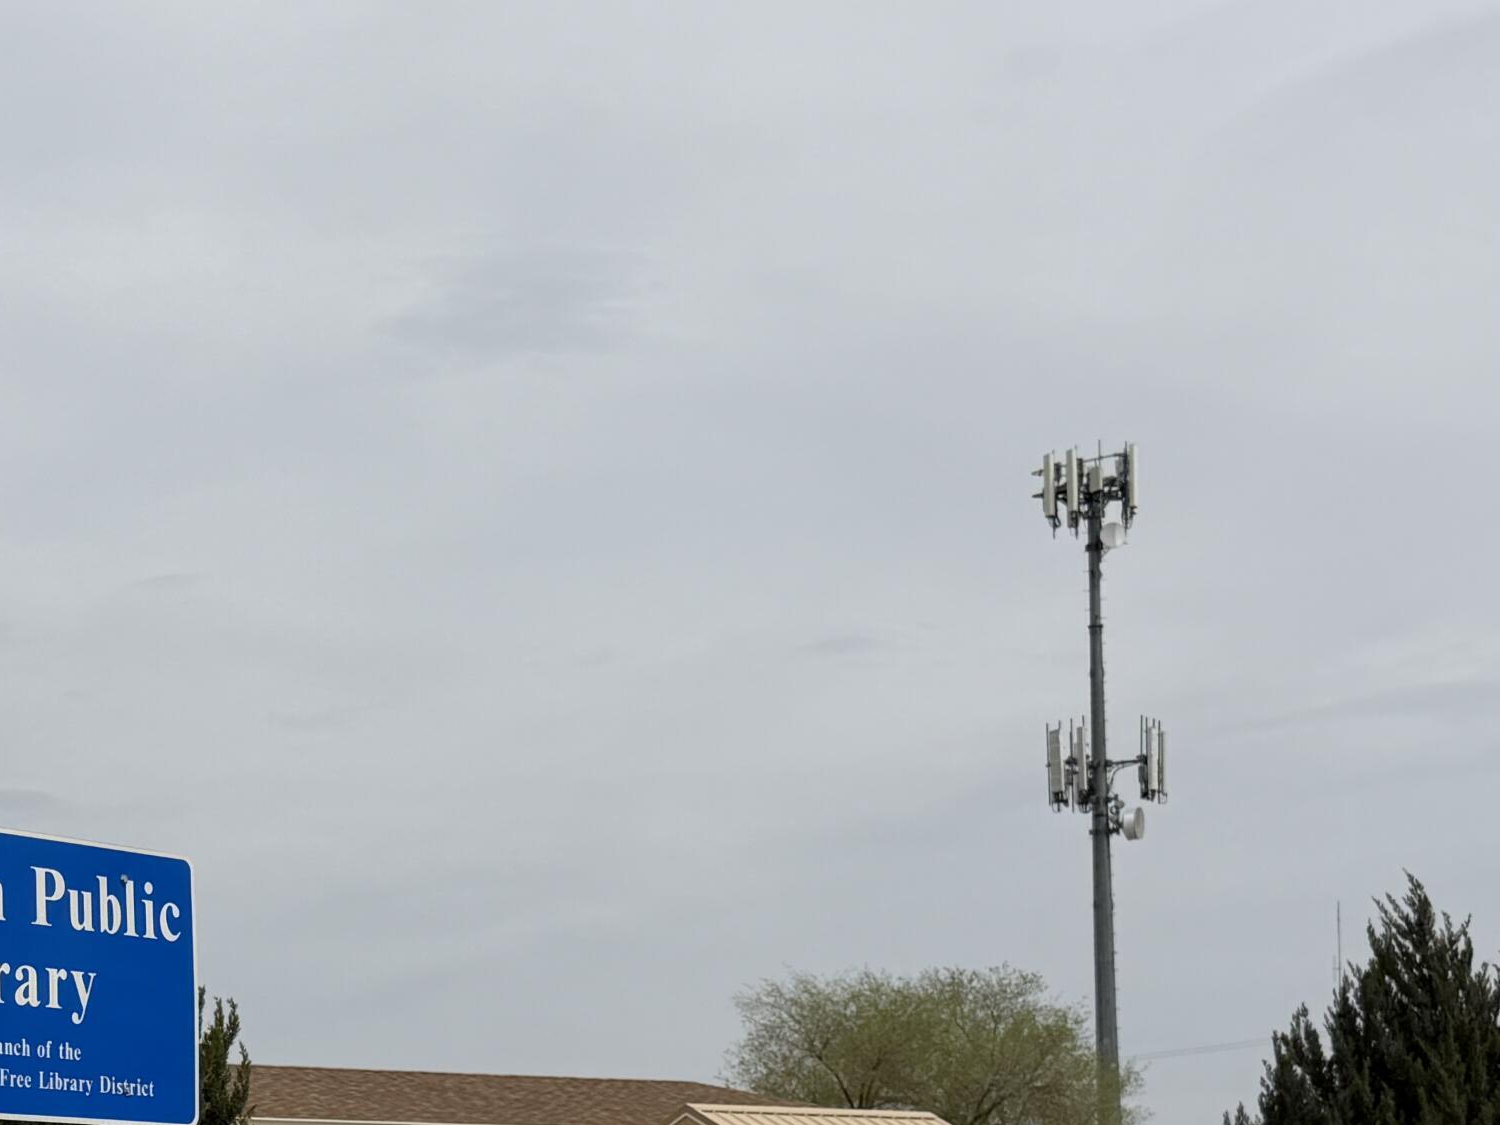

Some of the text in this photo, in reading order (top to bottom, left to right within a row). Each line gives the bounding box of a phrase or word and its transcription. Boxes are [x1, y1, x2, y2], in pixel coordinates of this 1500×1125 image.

[30, 866, 182, 942] Public
[37, 1040, 52, 1059] of
[59, 1042, 82, 1061] the
[0, 1068, 32, 1088] Free
[39, 1070, 93, 1096] Library
[100, 1075, 154, 1097] District
